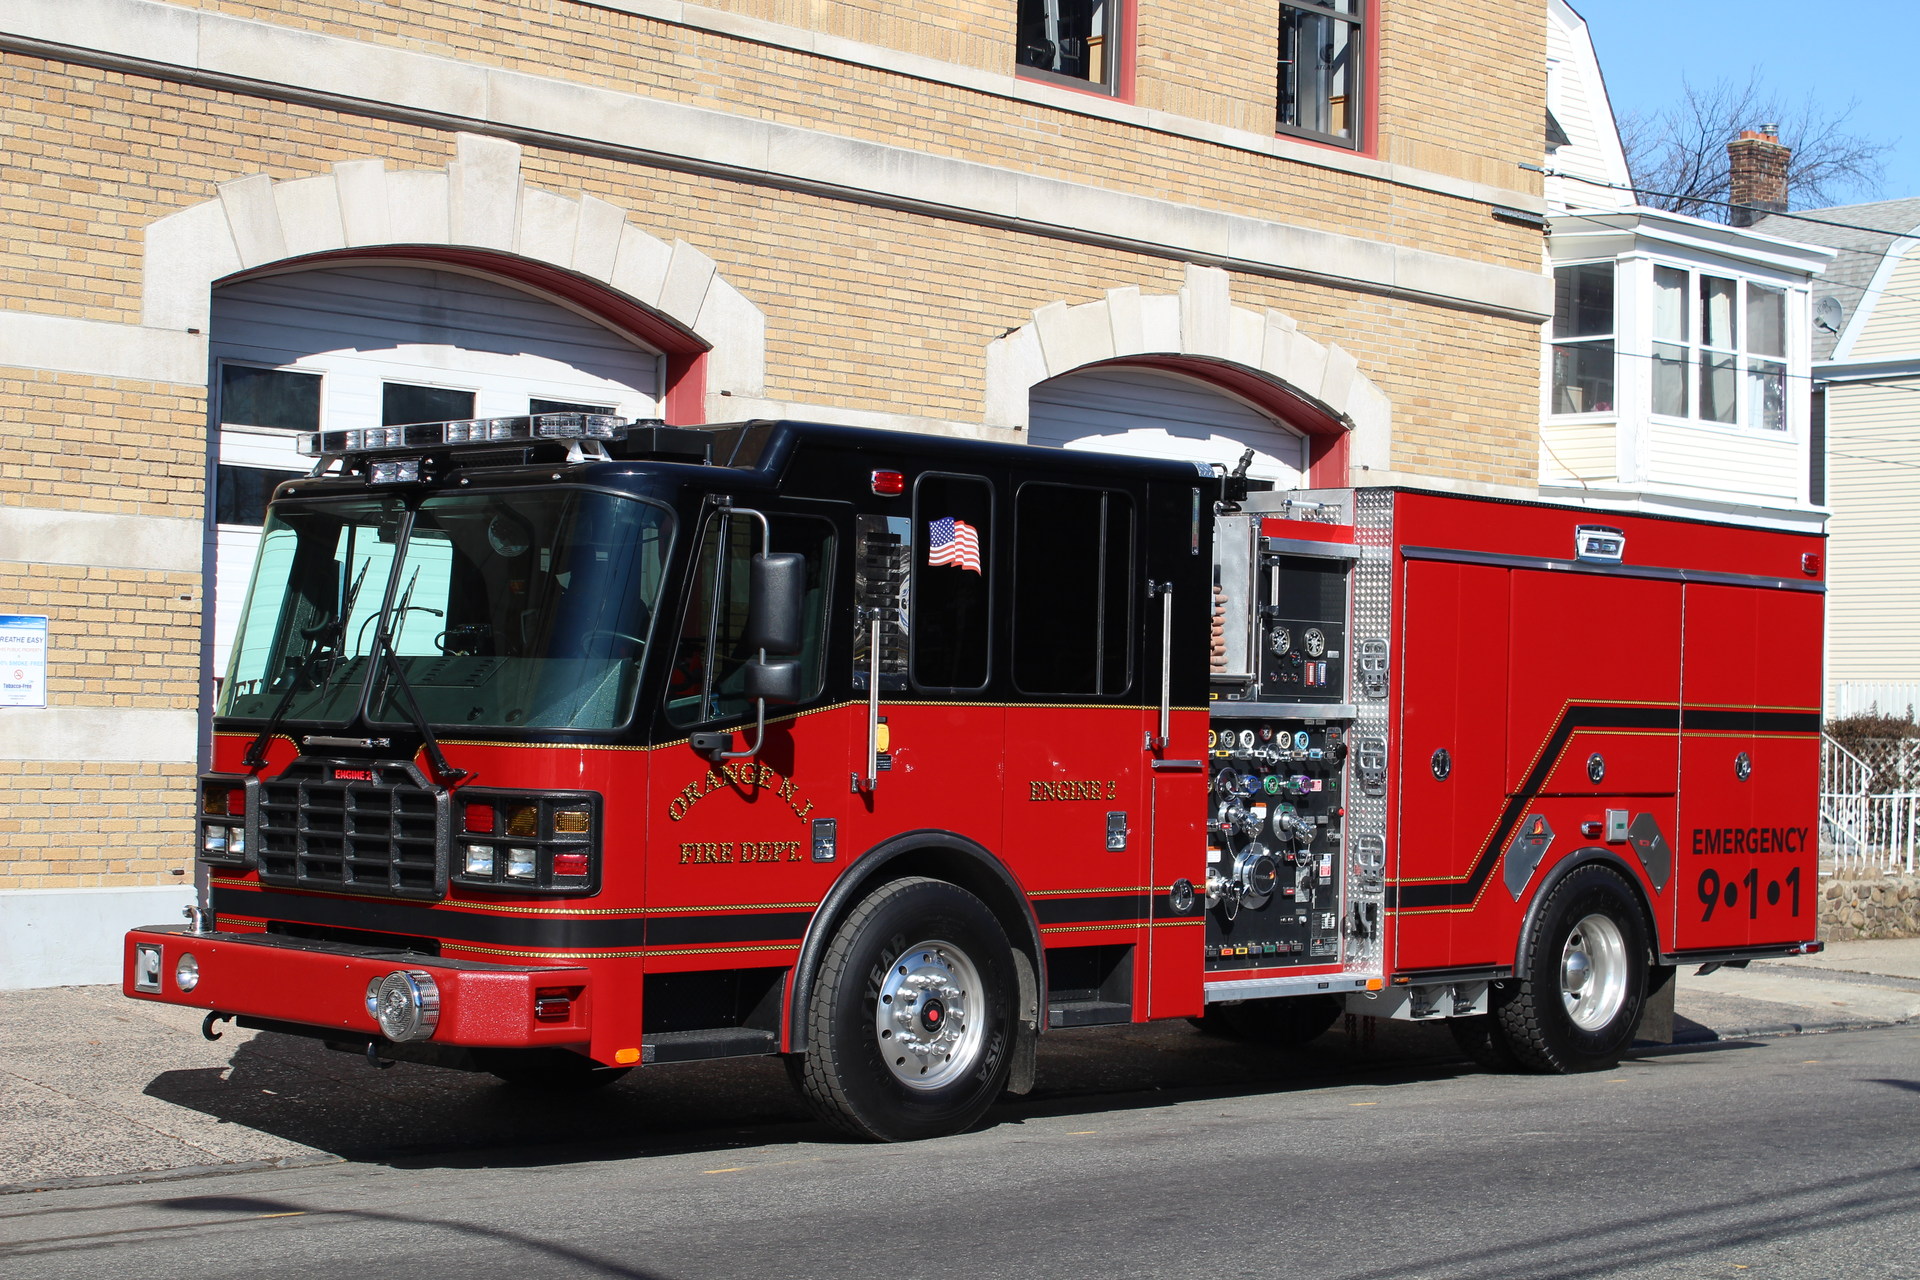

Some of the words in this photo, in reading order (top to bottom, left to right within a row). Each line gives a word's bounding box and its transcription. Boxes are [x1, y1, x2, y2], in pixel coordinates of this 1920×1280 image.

[335, 769, 365, 780] ENGINE
[365, 770, 372, 781] 2
[668, 762, 775, 822] ORANGE
[1029, 780, 1102, 801] ENGINE
[1106, 780, 1116, 800] 2
[679, 842, 735, 864] FIRE
[739, 841, 803, 863] DEPT.
[1692, 827, 1808, 855] EMERGENCY
[975, 1030, 1003, 1083] MSA
